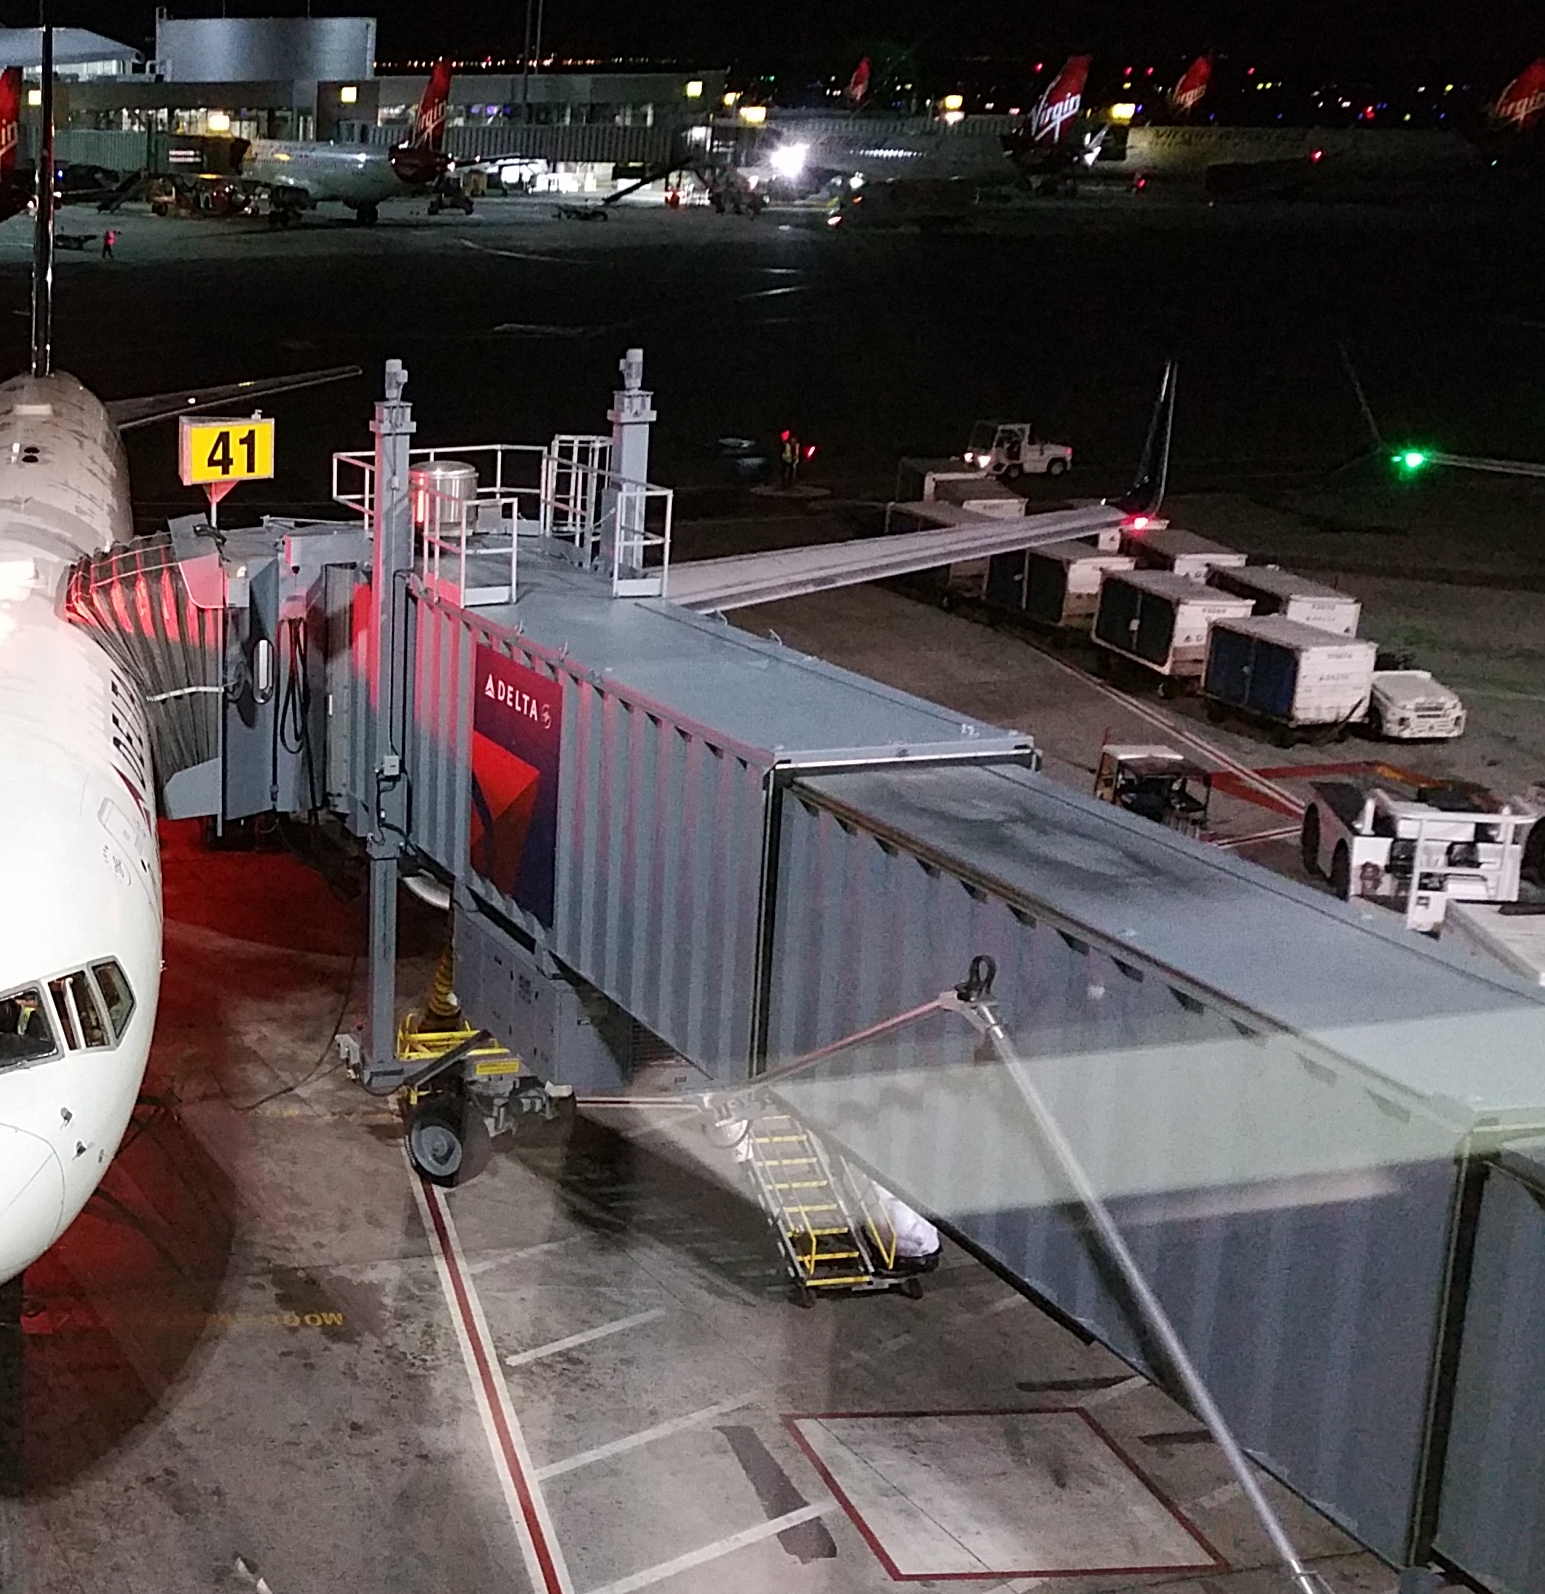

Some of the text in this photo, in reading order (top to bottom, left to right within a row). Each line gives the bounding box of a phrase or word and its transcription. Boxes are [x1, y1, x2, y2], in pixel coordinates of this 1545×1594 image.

[1030, 74, 1082, 144] Virgin
[206, 428, 256, 476] 41
[497, 679, 538, 721] DELTA
